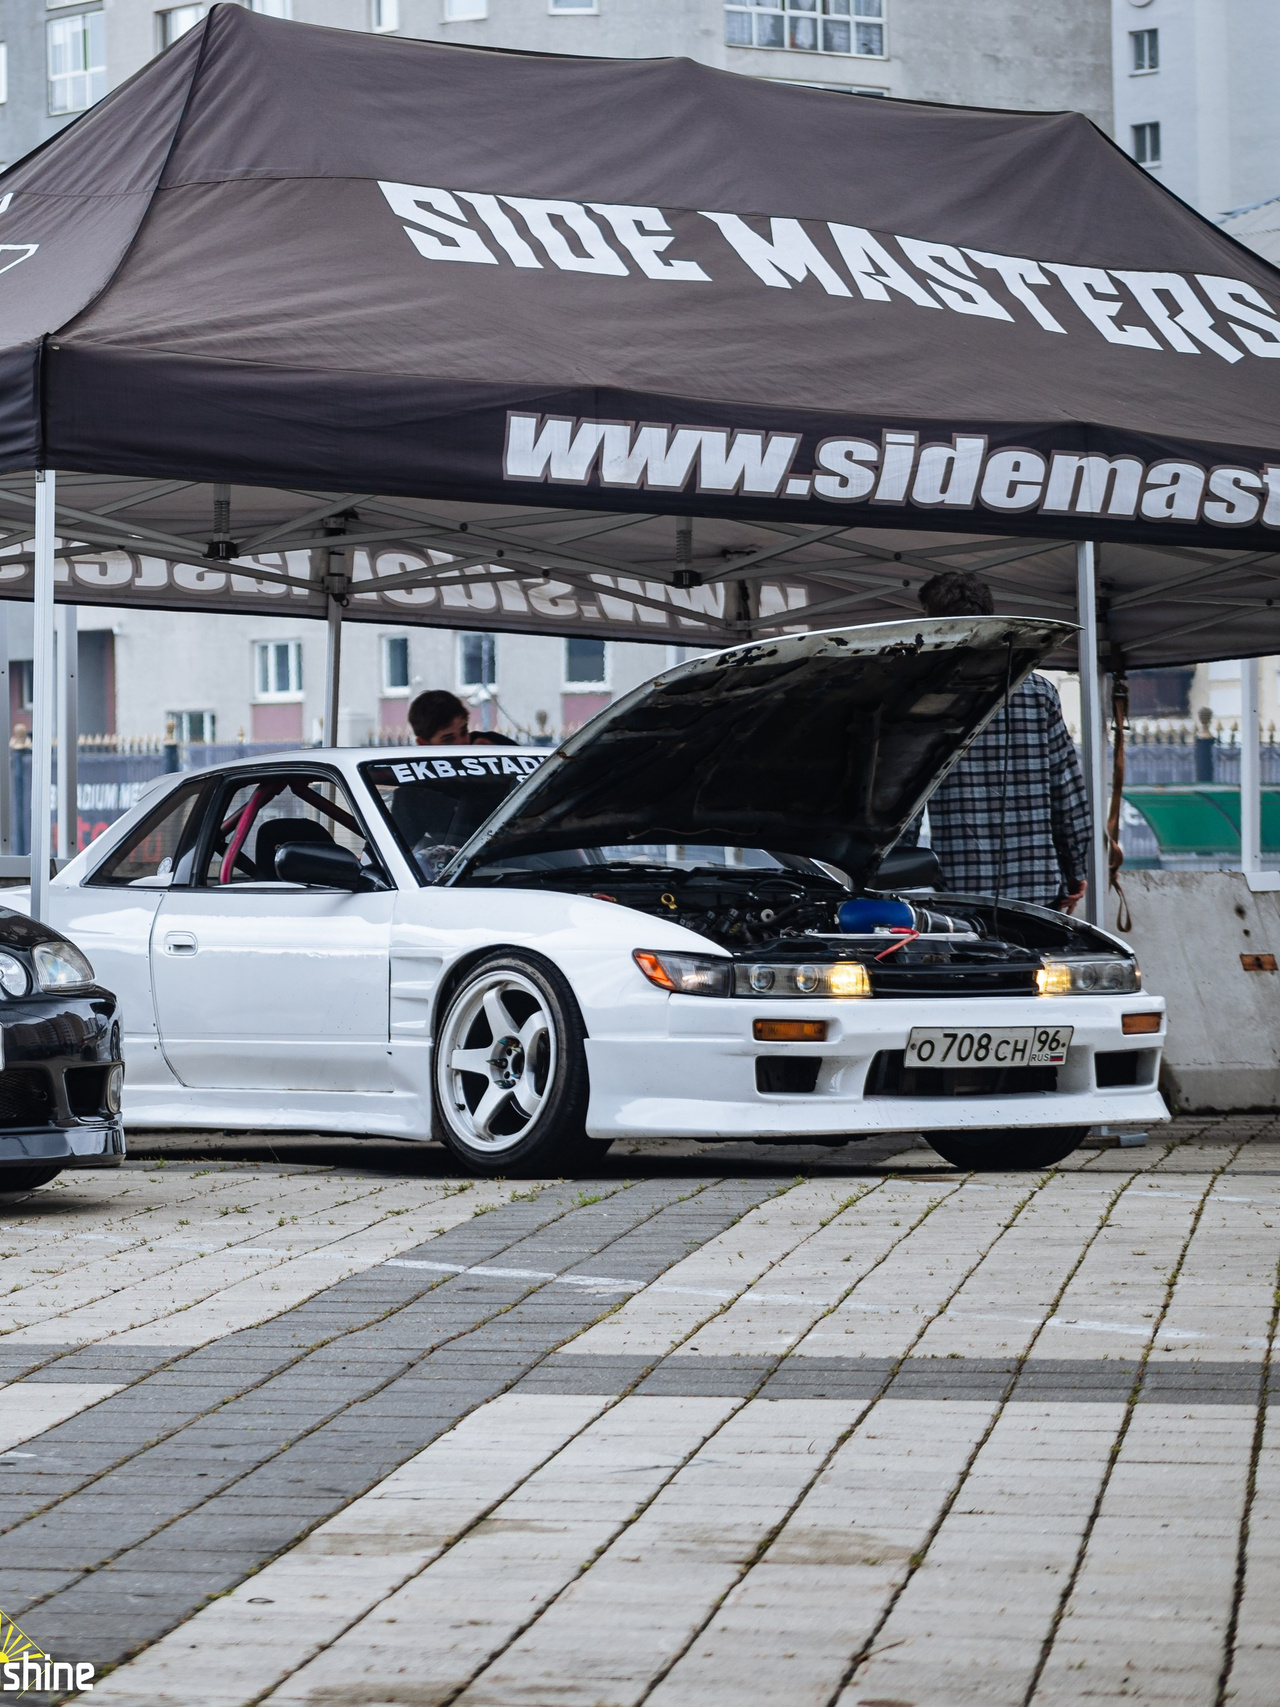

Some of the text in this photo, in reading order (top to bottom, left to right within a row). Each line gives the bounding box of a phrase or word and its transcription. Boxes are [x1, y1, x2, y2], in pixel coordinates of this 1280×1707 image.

[376, 180, 1280, 364] SIDE MASTERS
[1036, 1030, 1062, 1052] 96
[1030, 1053, 1050, 1062] RUS
